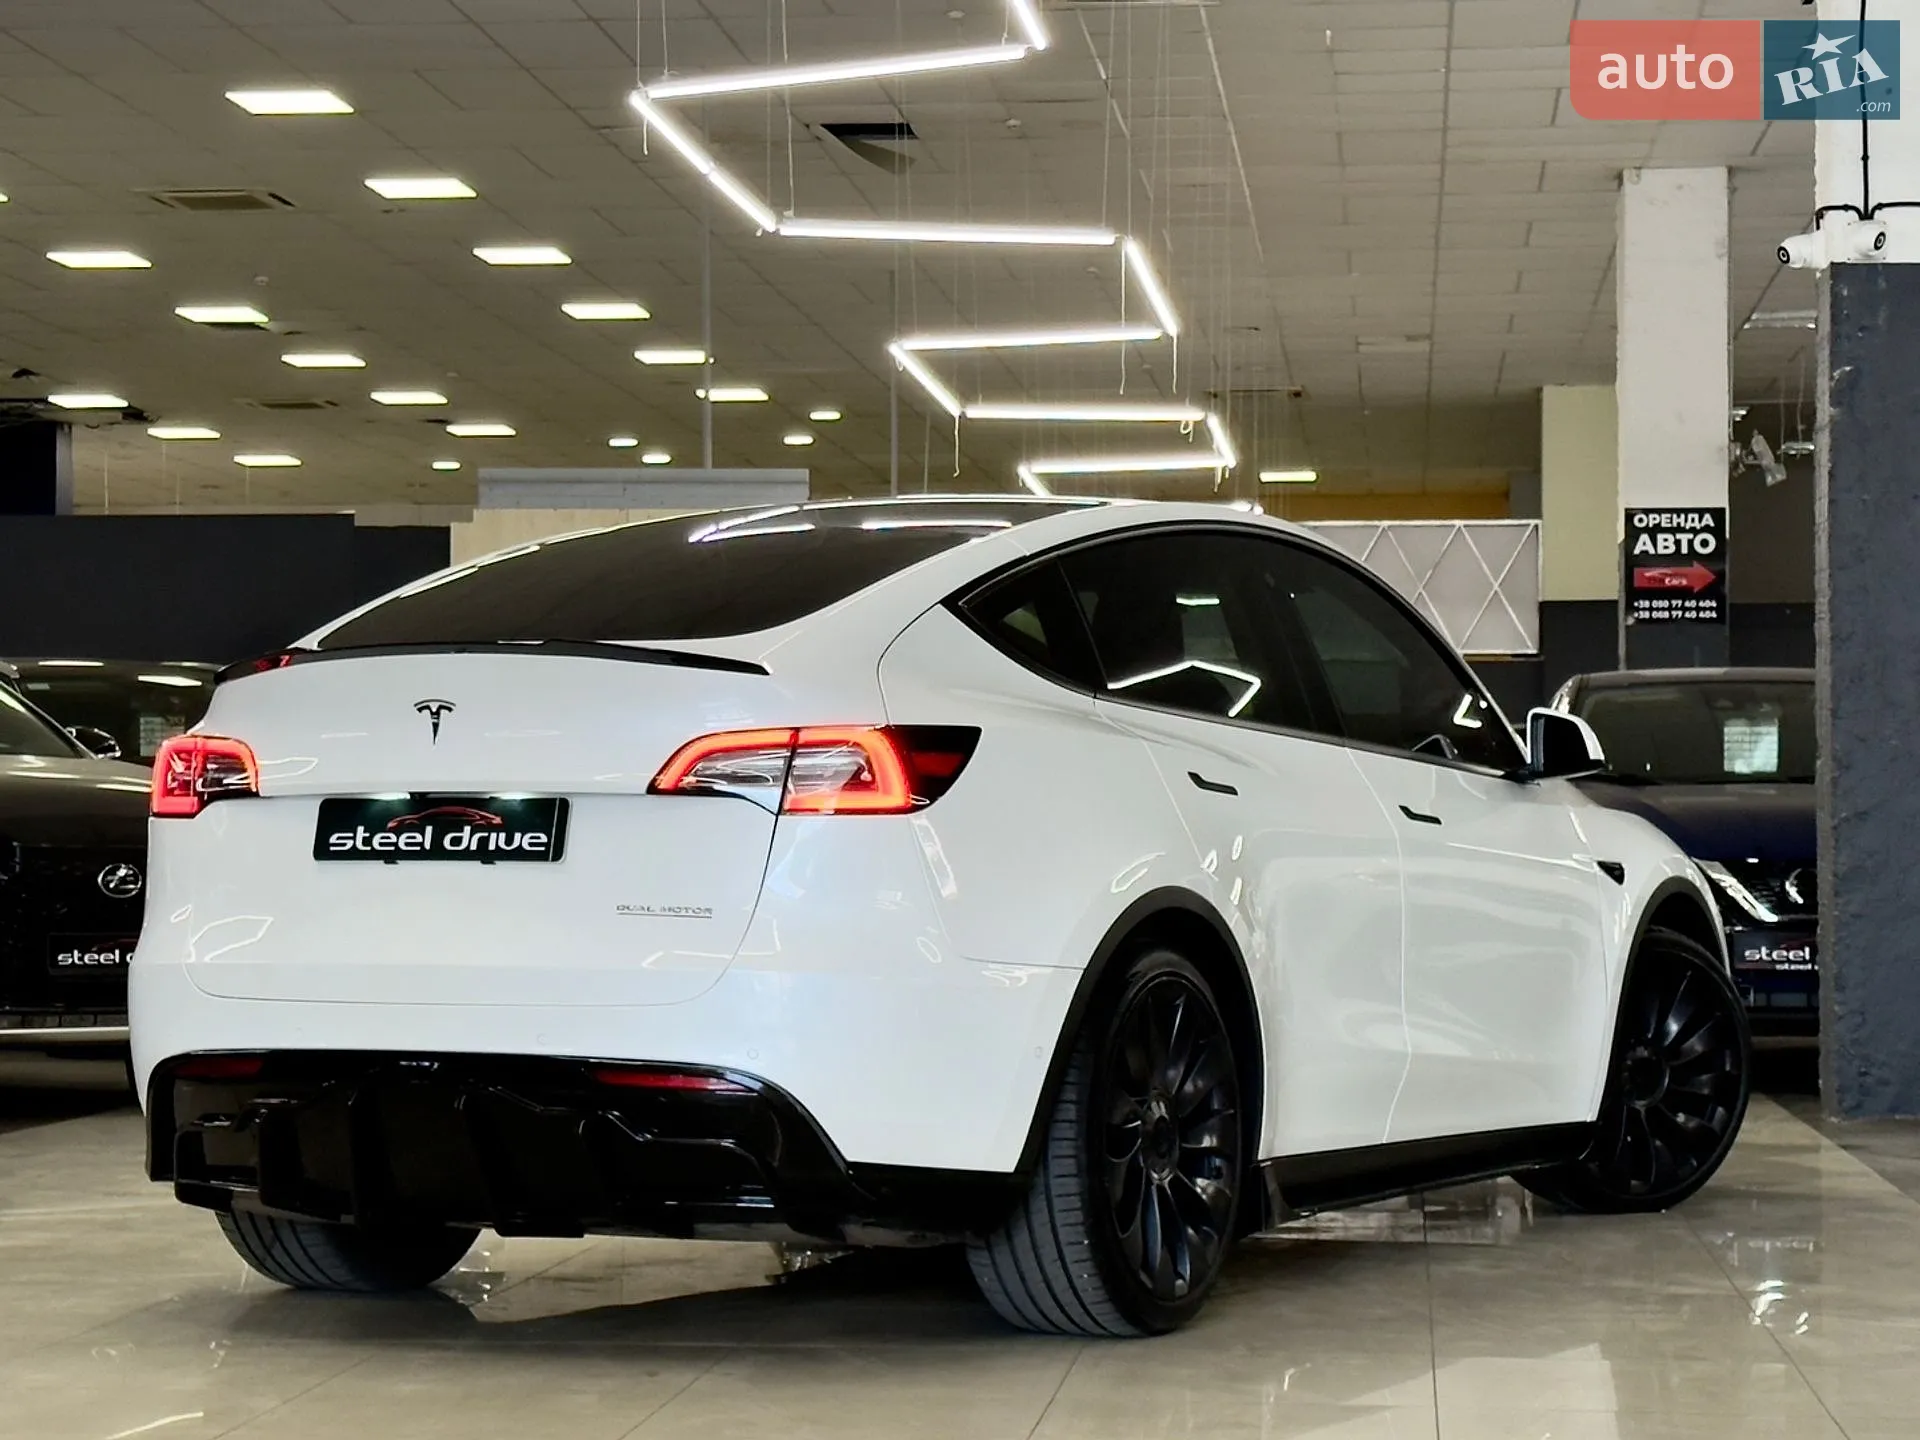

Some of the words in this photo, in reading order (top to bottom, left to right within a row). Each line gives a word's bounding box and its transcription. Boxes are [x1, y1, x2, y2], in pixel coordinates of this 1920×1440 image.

[1633, 513, 1715, 530] ОРЕНДА
[1633, 532, 1717, 555] АВТО
[1634, 600, 1650, 608] +38
[1671, 600, 1682, 608] 77
[1634, 610, 1650, 619] +38
[1671, 610, 1682, 619] 77
[329, 825, 433, 851] steel
[443, 825, 549, 851] drive
[616, 904, 656, 914] DUAL
[660, 905, 713, 916] MOTOR
[57, 949, 120, 966] steel
[1744, 945, 1811, 962] steel
